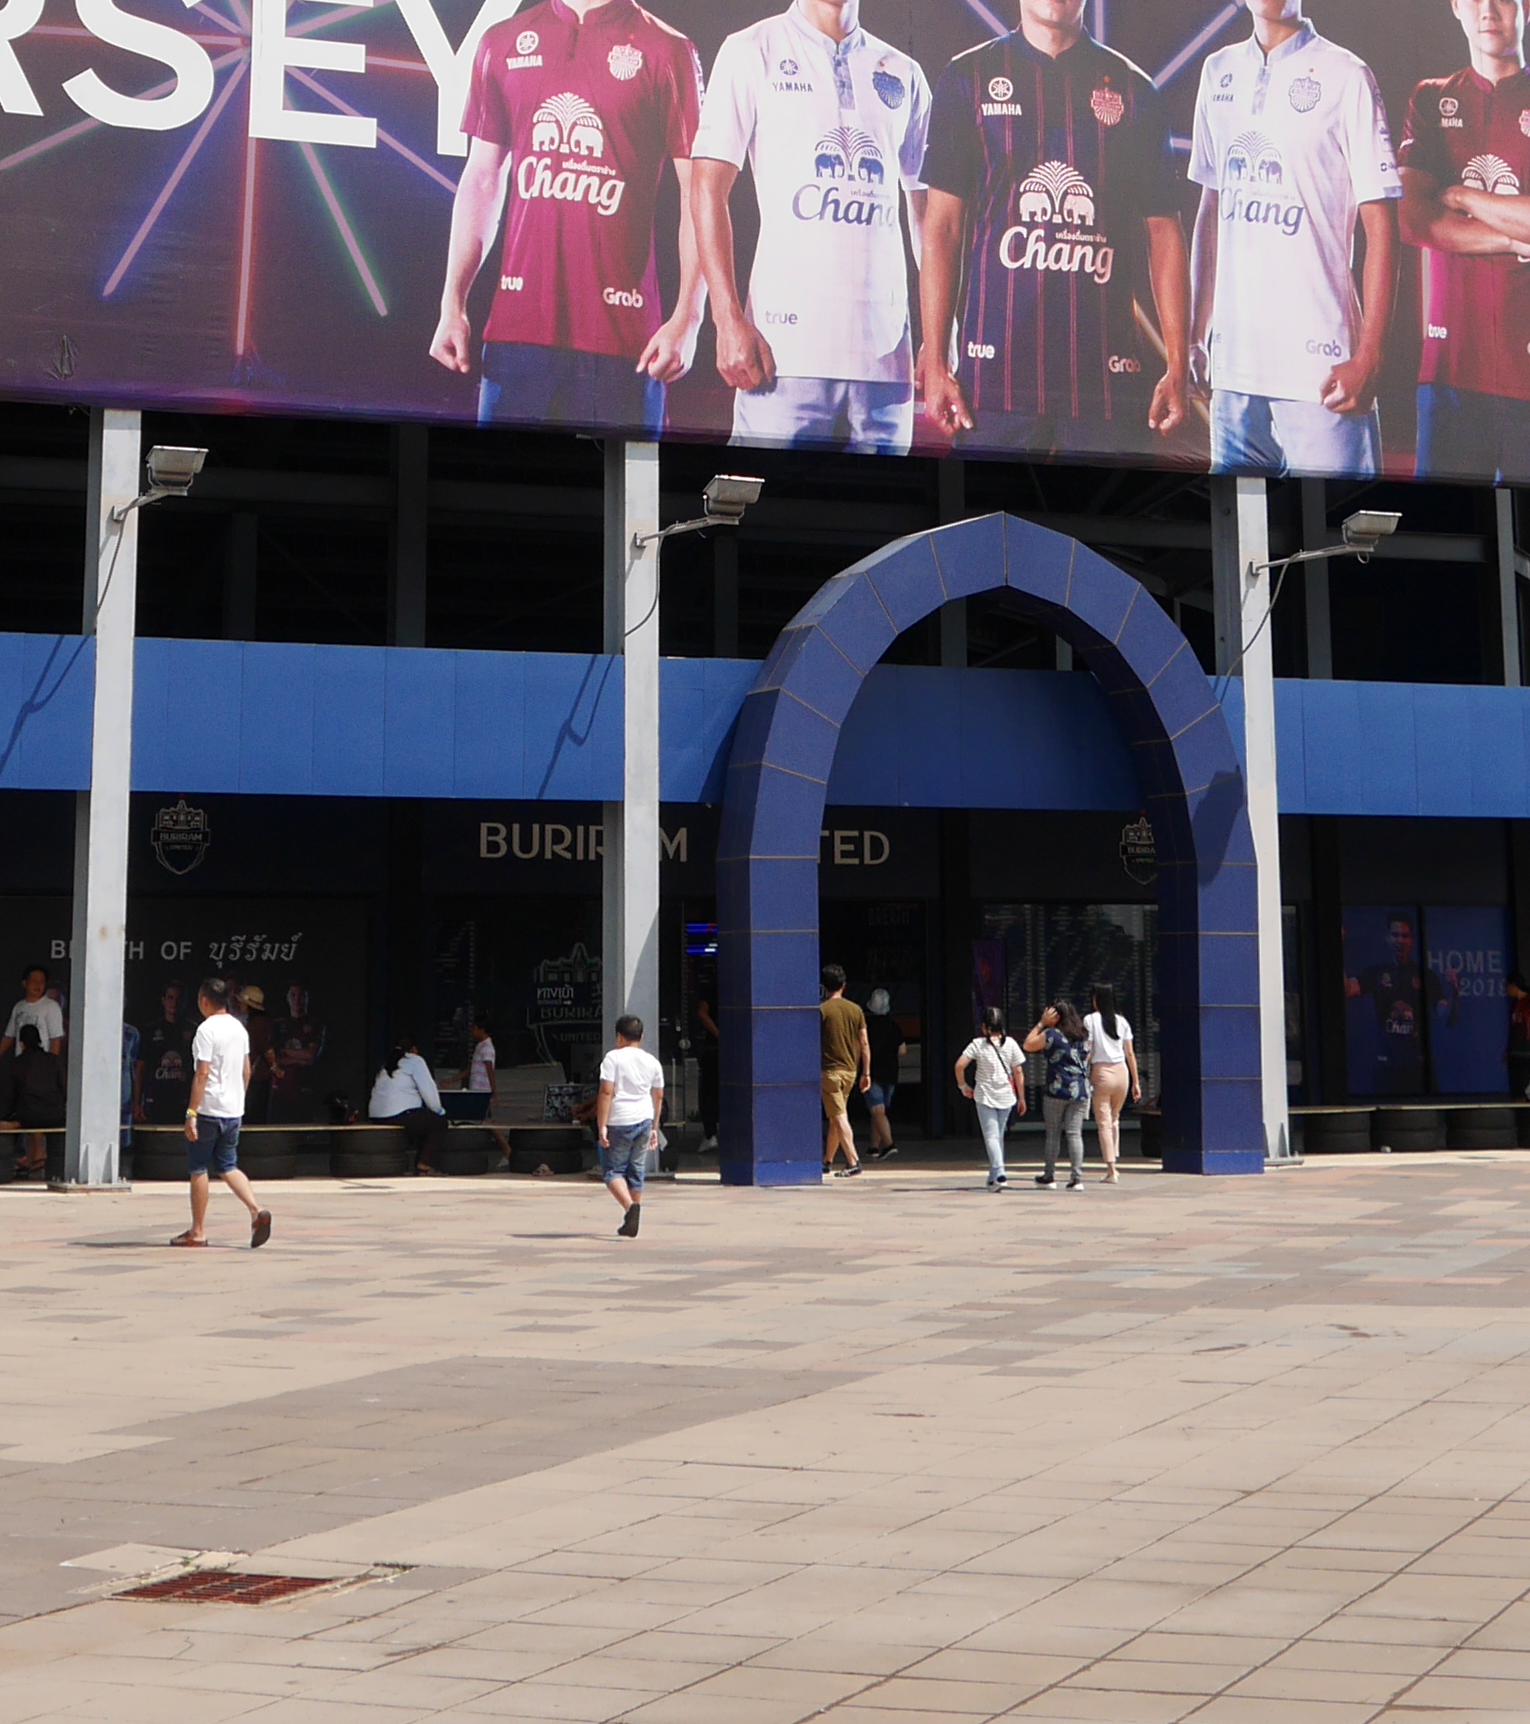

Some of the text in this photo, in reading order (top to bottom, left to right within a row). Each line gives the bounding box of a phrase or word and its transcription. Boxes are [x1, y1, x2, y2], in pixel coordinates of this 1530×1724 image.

[506, 55, 543, 70] YAMAHA
[773, 82, 813, 93] YAMAHA
[981, 103, 1022, 117] YAMAHA
[518, 156, 625, 216] Chang
[999, 226, 1115, 284] Chang
[603, 287, 644, 308] Grab
[765, 310, 798, 326] true
[968, 342, 1141, 374] true Grab
[1305, 339, 1343, 358] Grab
[160, 941, 192, 960] OF
[1427, 950, 1503, 974] HOME
